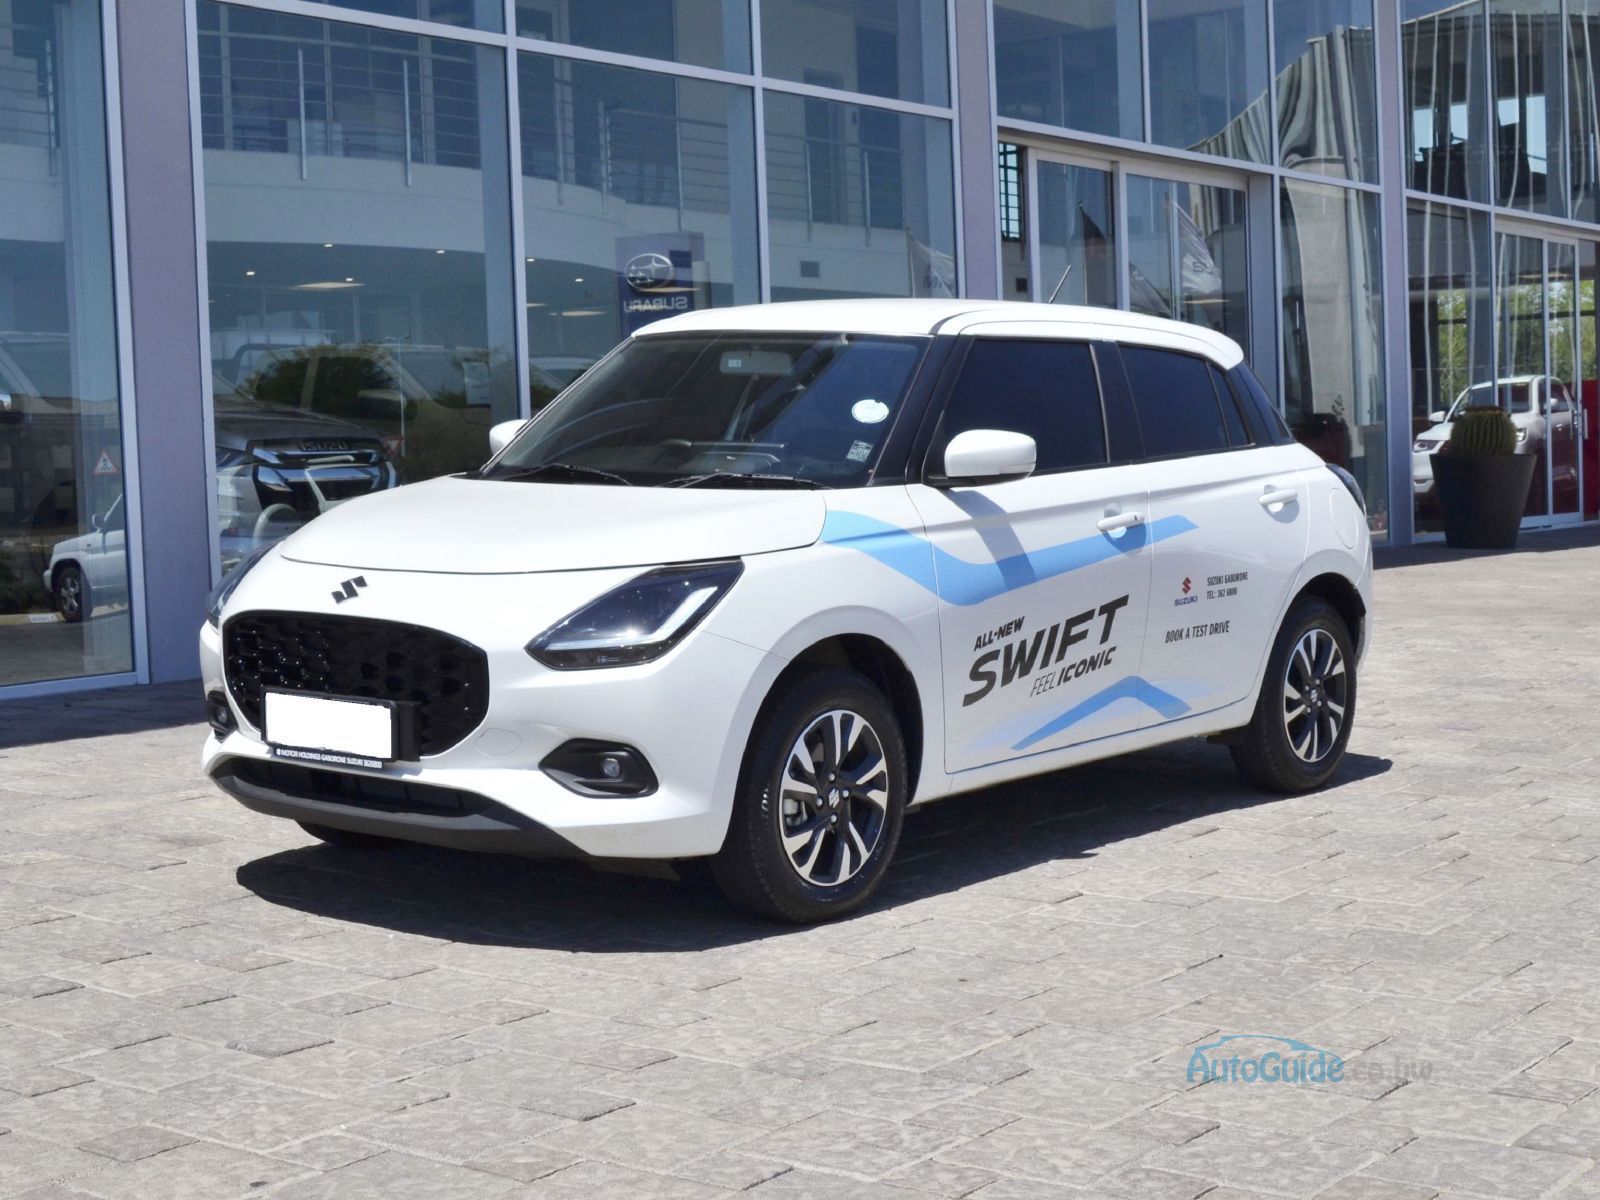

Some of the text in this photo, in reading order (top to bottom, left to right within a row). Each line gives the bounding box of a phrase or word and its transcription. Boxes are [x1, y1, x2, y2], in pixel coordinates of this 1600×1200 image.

[301, 440, 350, 451] ISUZU
[1207, 575, 1224, 586] SUZUKI
[1174, 596, 1198, 606] SUZUKI
[974, 616, 1025, 651] ALL-NEW
[1165, 620, 1230, 644] BOOK A TEST DRIVE
[962, 594, 1129, 707] SWIFT
[1030, 646, 1117, 697] FEEL ICONIC
[280, 748, 298, 758] MOTOR
[346, 757, 363, 766] SUZUKI
